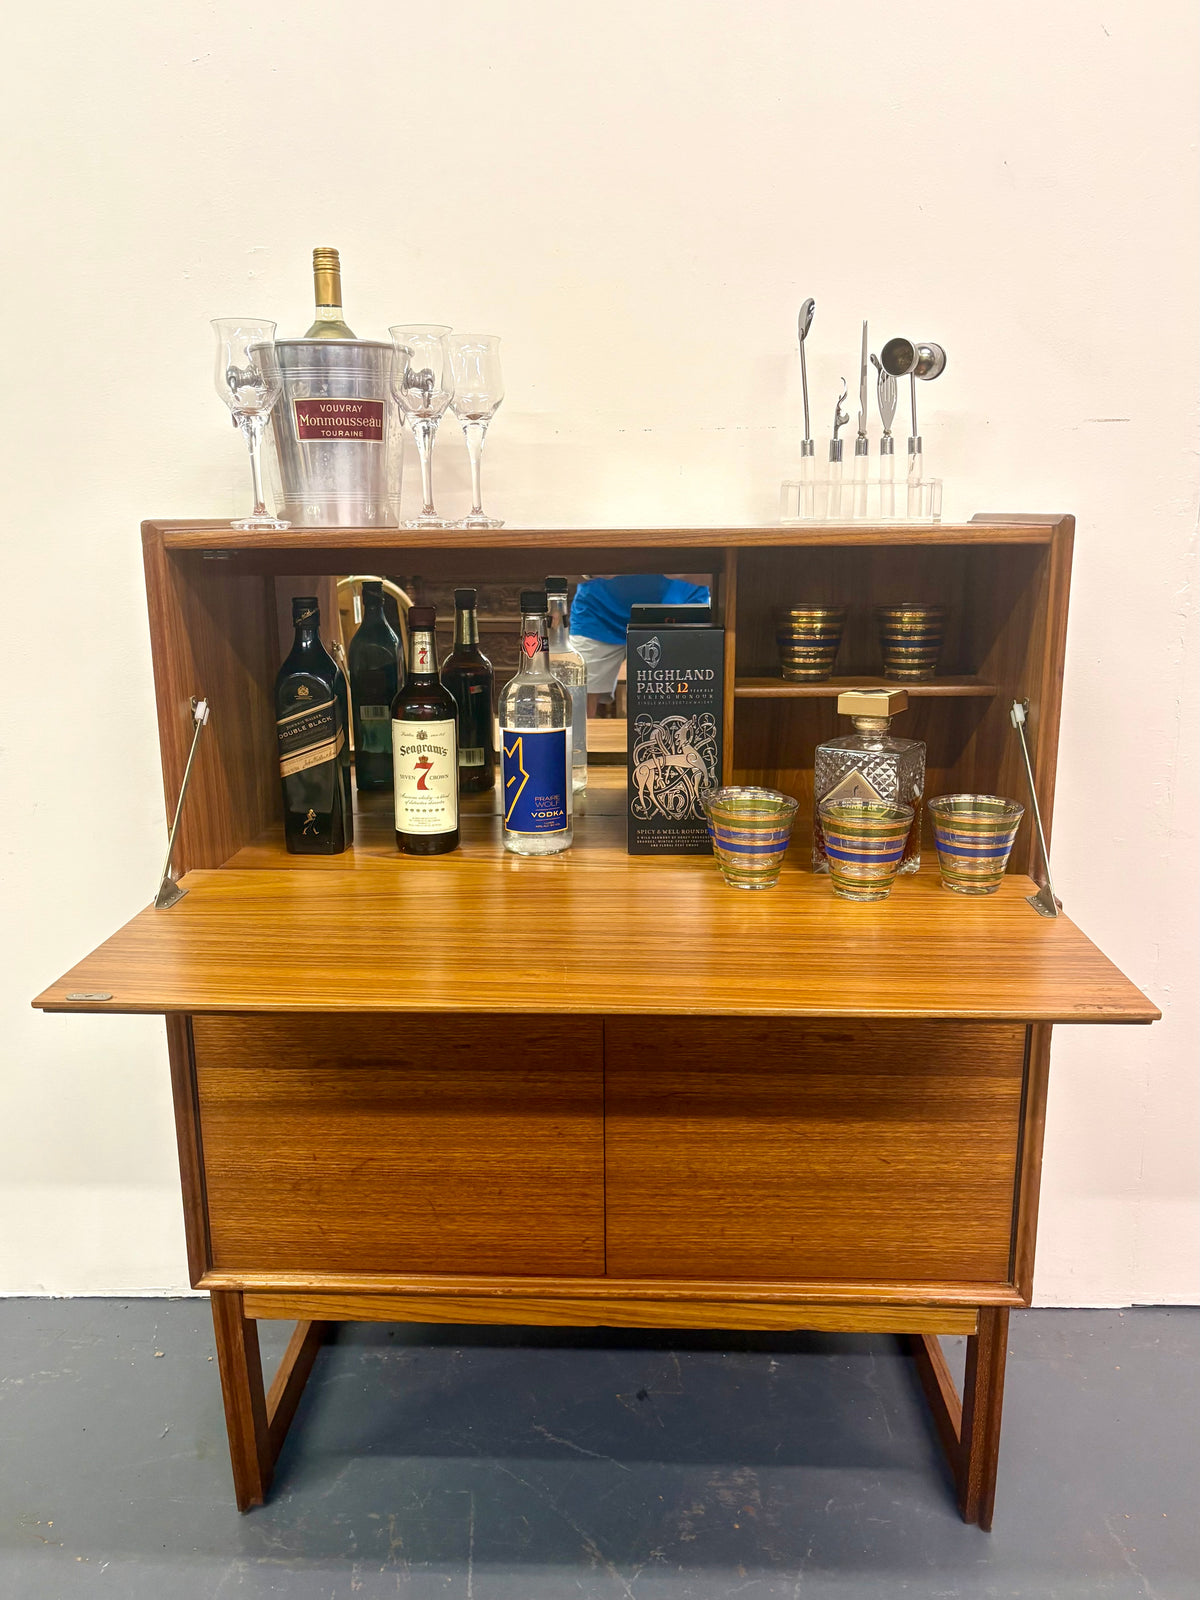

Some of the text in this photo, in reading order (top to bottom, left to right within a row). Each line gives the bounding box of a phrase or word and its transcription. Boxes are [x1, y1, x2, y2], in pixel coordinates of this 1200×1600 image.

[320, 404, 363, 413] VOUVRAY
[299, 414, 382, 428] Monmousseau
[418, 650, 428, 665] 7
[636, 669, 715, 681] HIGHLAND
[636, 682, 675, 694] PARK
[677, 682, 689, 693] 12
[278, 724, 307, 740] DOUBLE
[308, 716, 333, 729] BLACK
[399, 743, 448, 757] Seagram's
[413, 761, 435, 791] 7
[531, 809, 564, 818] VODKA
